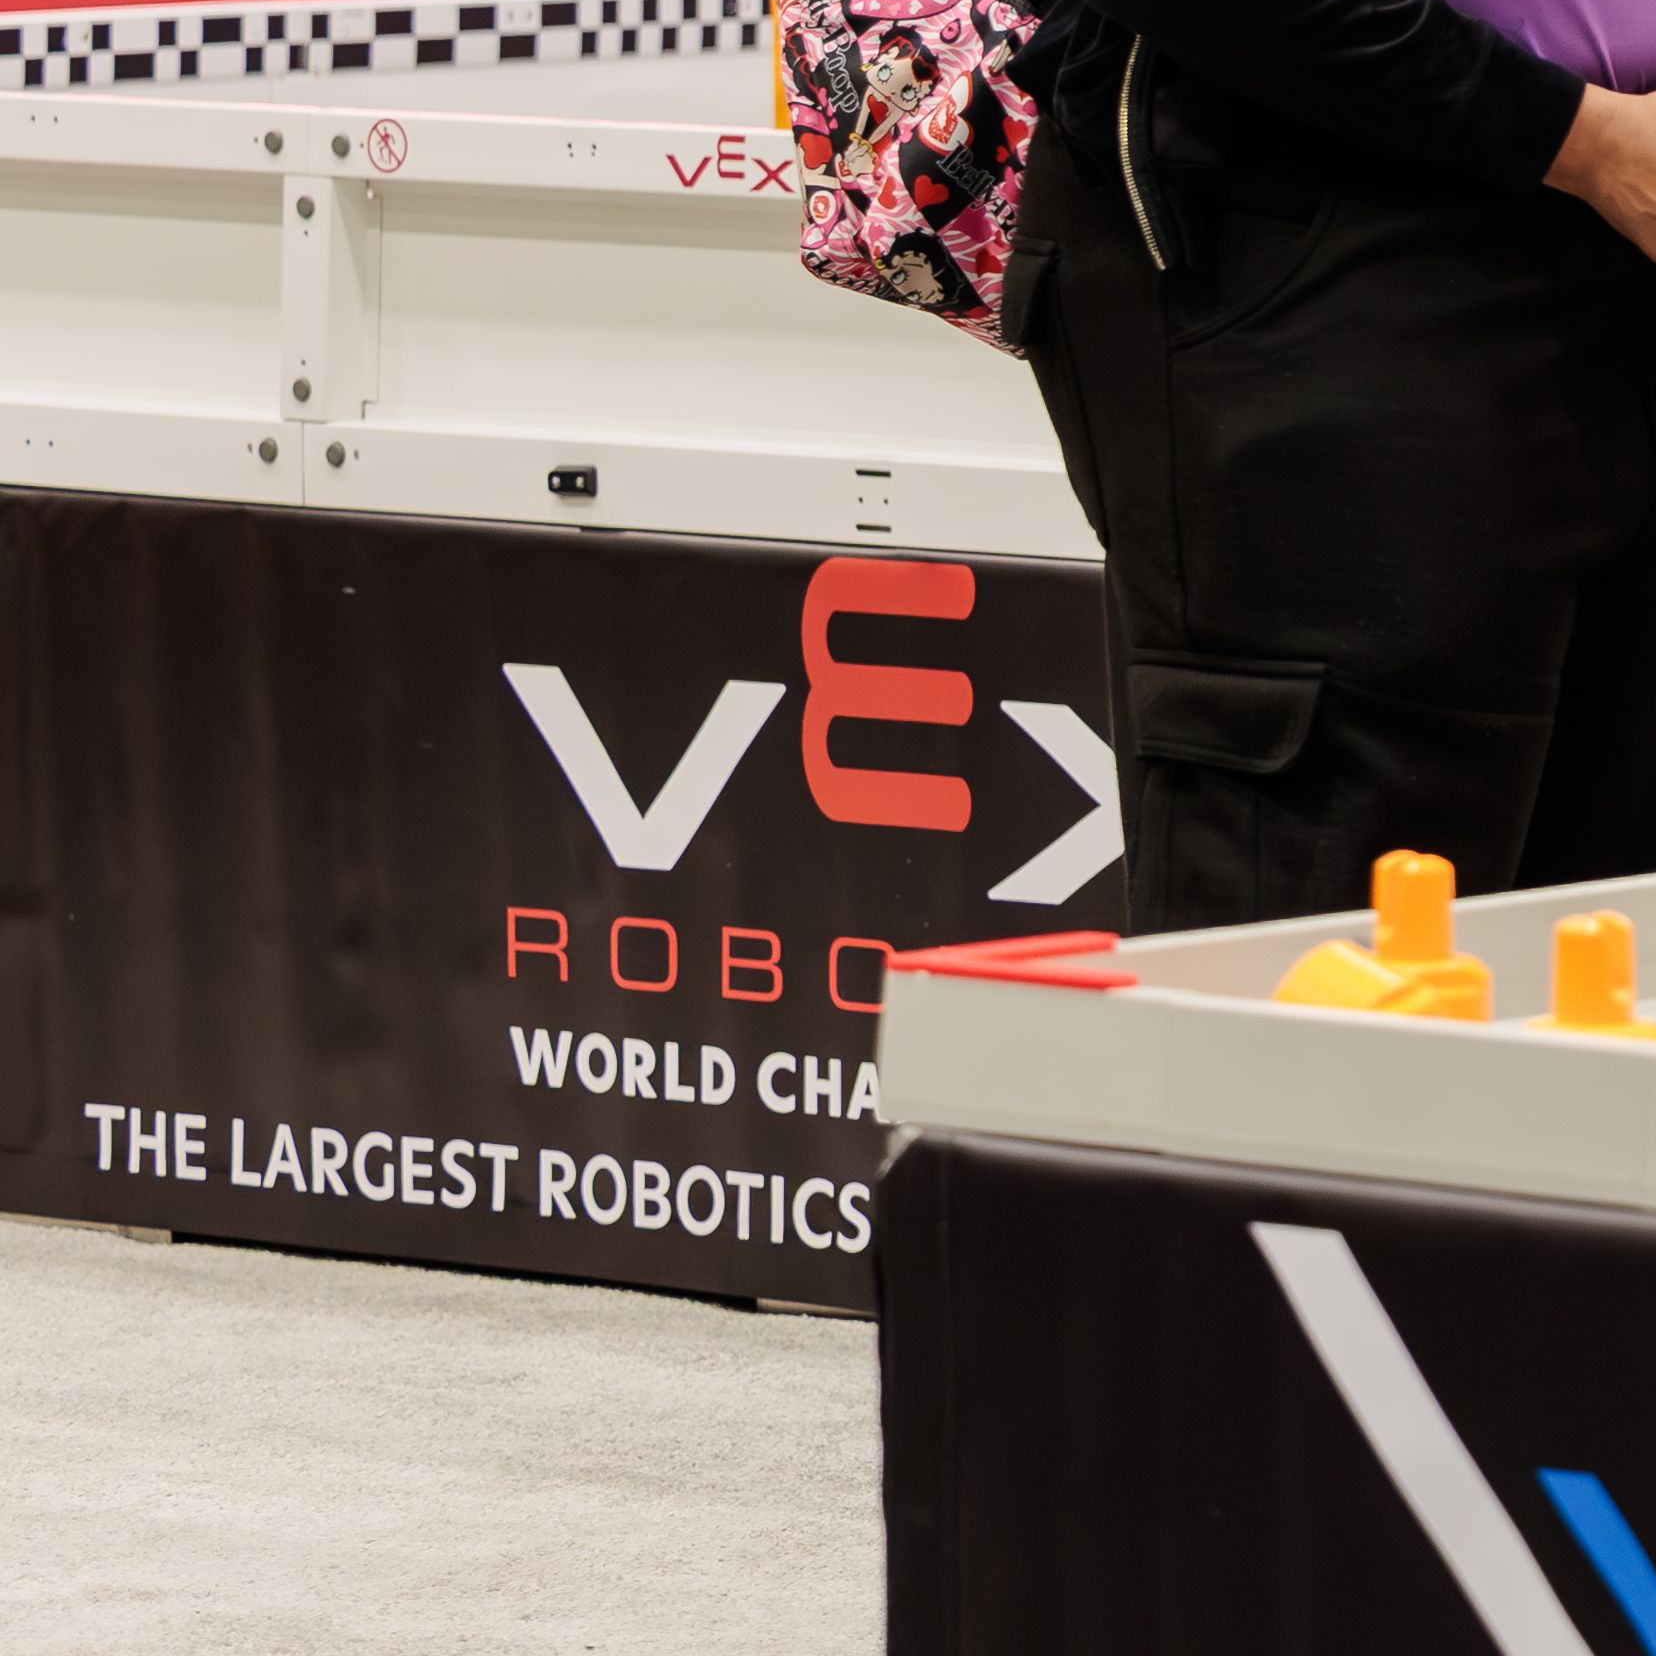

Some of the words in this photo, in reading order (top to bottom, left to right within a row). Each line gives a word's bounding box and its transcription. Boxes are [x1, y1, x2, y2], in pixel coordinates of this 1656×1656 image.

[665, 134, 795, 194] VEX
[509, 1026, 736, 1106] WORLD
[85, 1102, 207, 1182] THE
[230, 1116, 519, 1214] LARGEST
[538, 1147, 873, 1254] ROBOTICS
